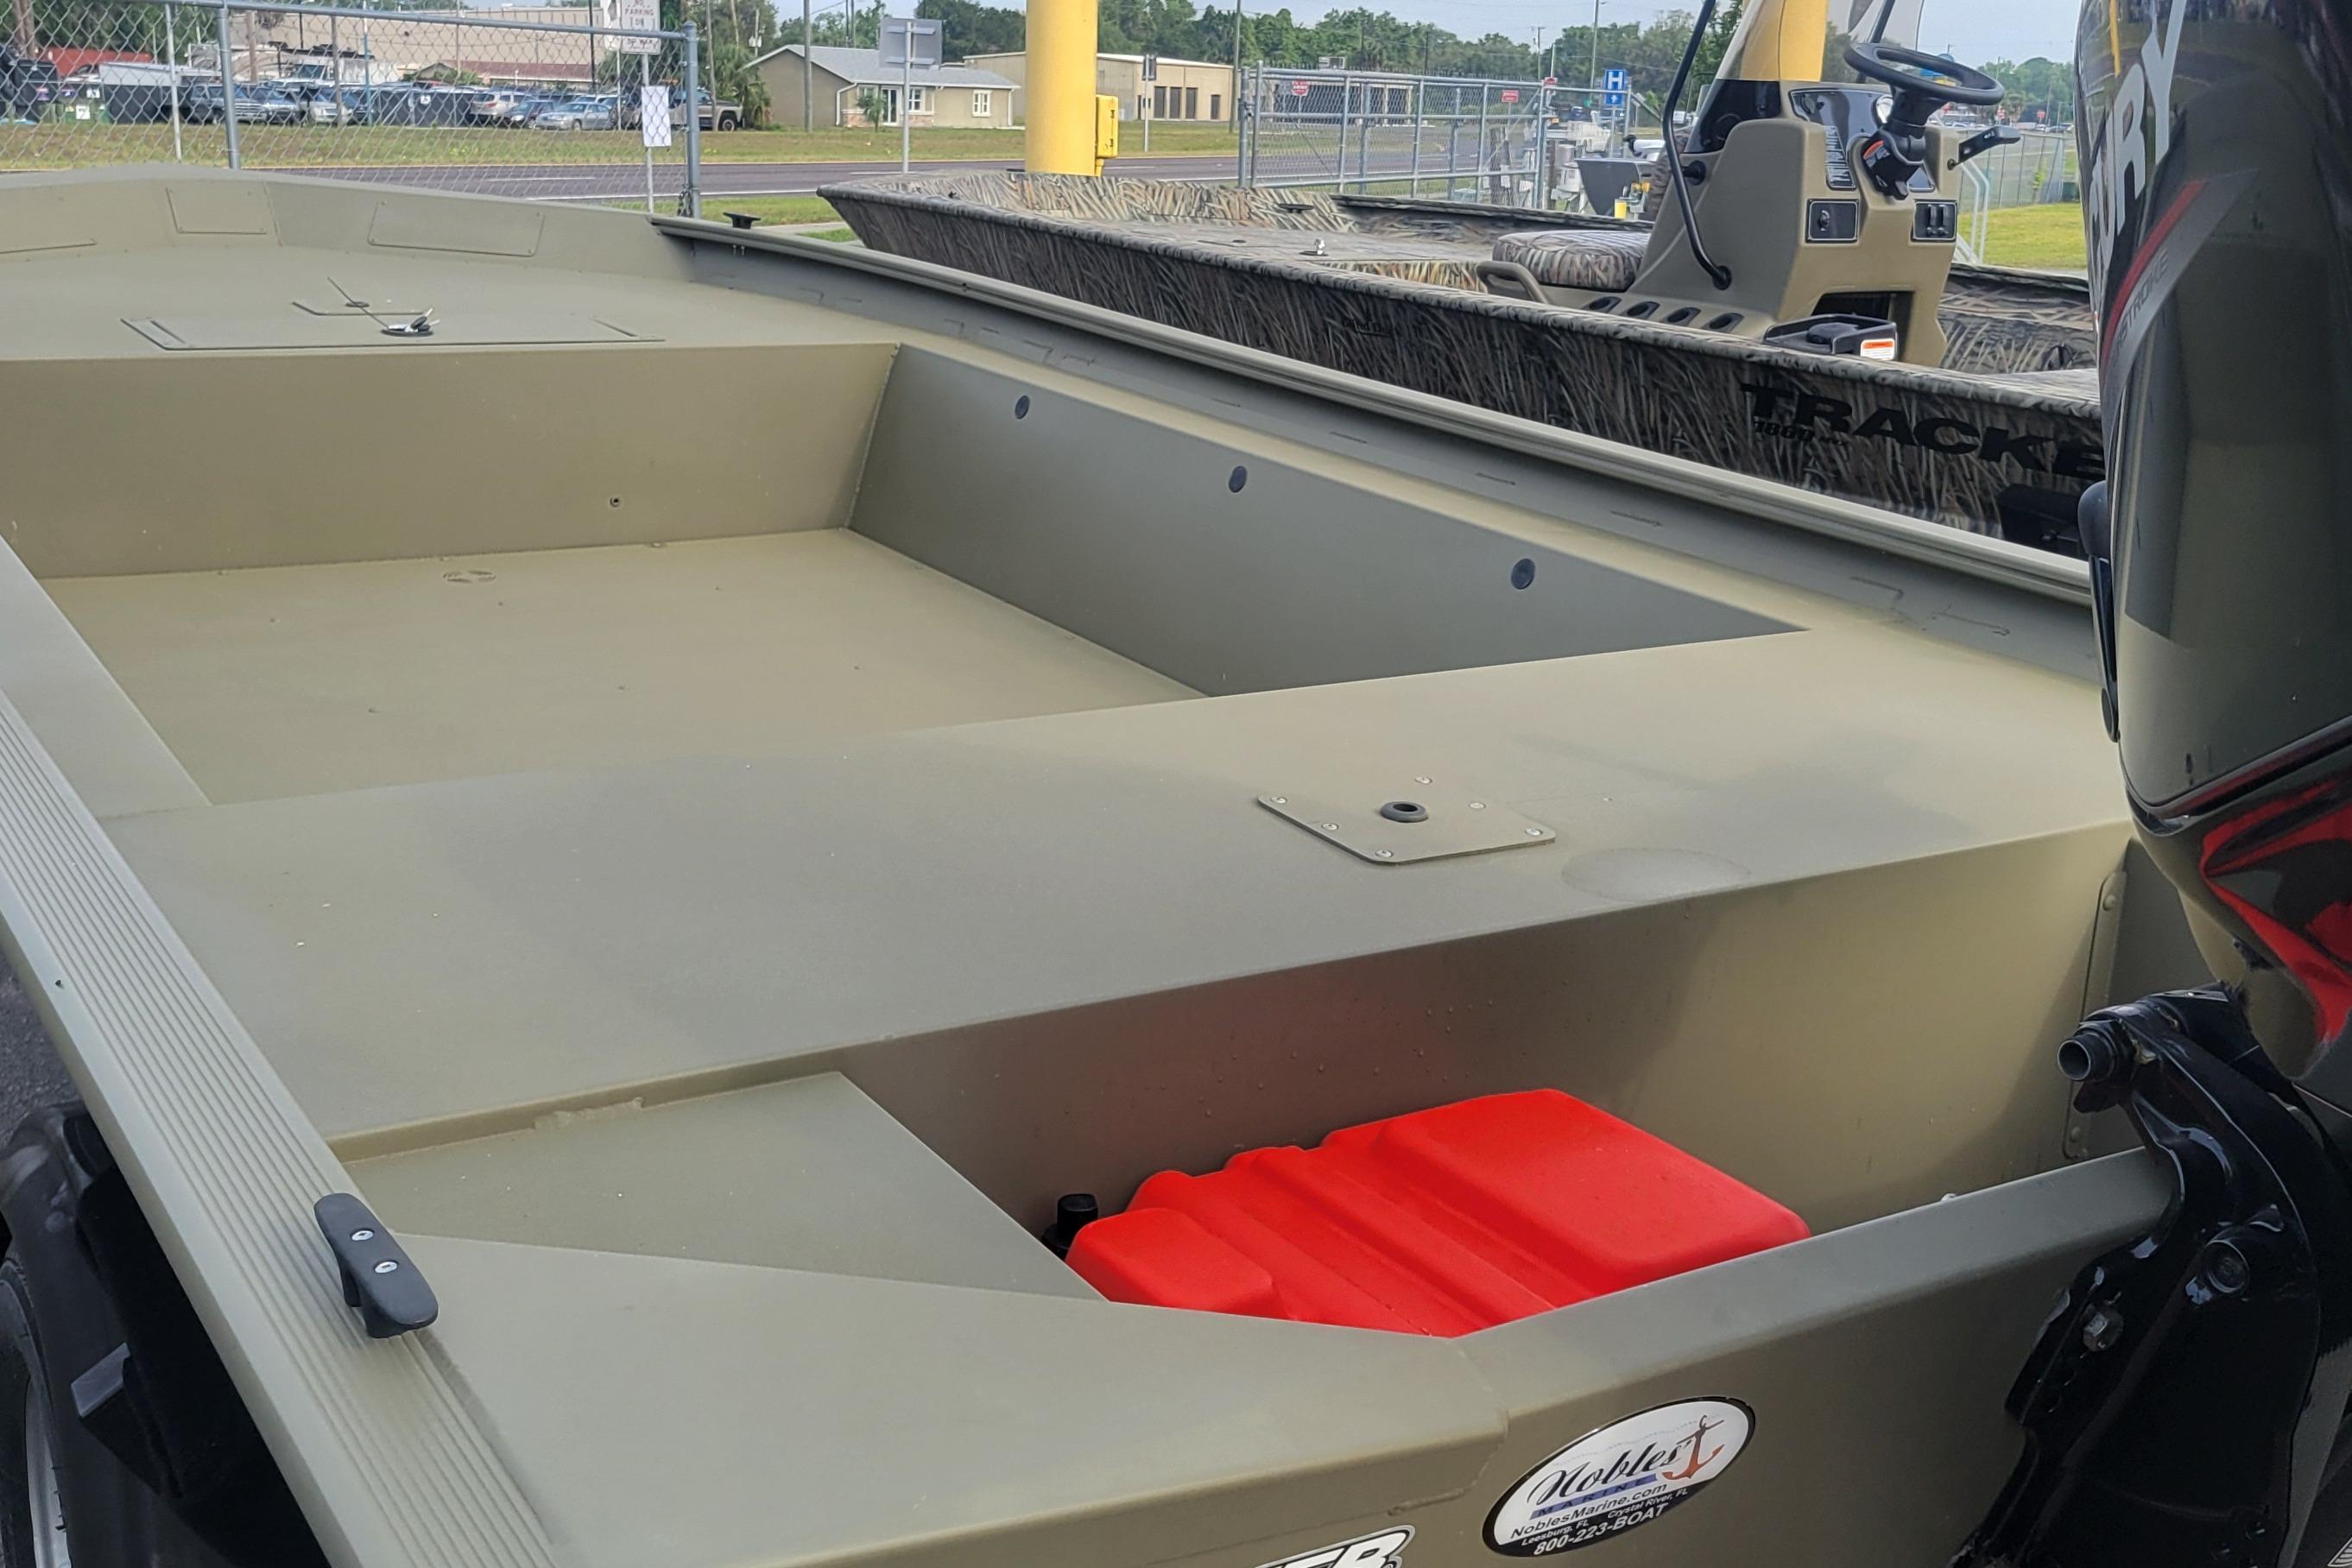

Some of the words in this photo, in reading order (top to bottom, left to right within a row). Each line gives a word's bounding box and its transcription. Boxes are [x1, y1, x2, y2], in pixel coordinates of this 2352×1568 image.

[1608, 72, 1622, 90] H
[1511, 1483, 1667, 1540] NoblesMarine.com
[1537, 1476, 1649, 1517] MARINE
[1576, 1519, 1590, 1530] FL
[1608, 1501, 1643, 1520] Crystal
[1676, 1488, 1688, 1498] FL
[1533, 1502, 1669, 1555] 800-223-BOAT
